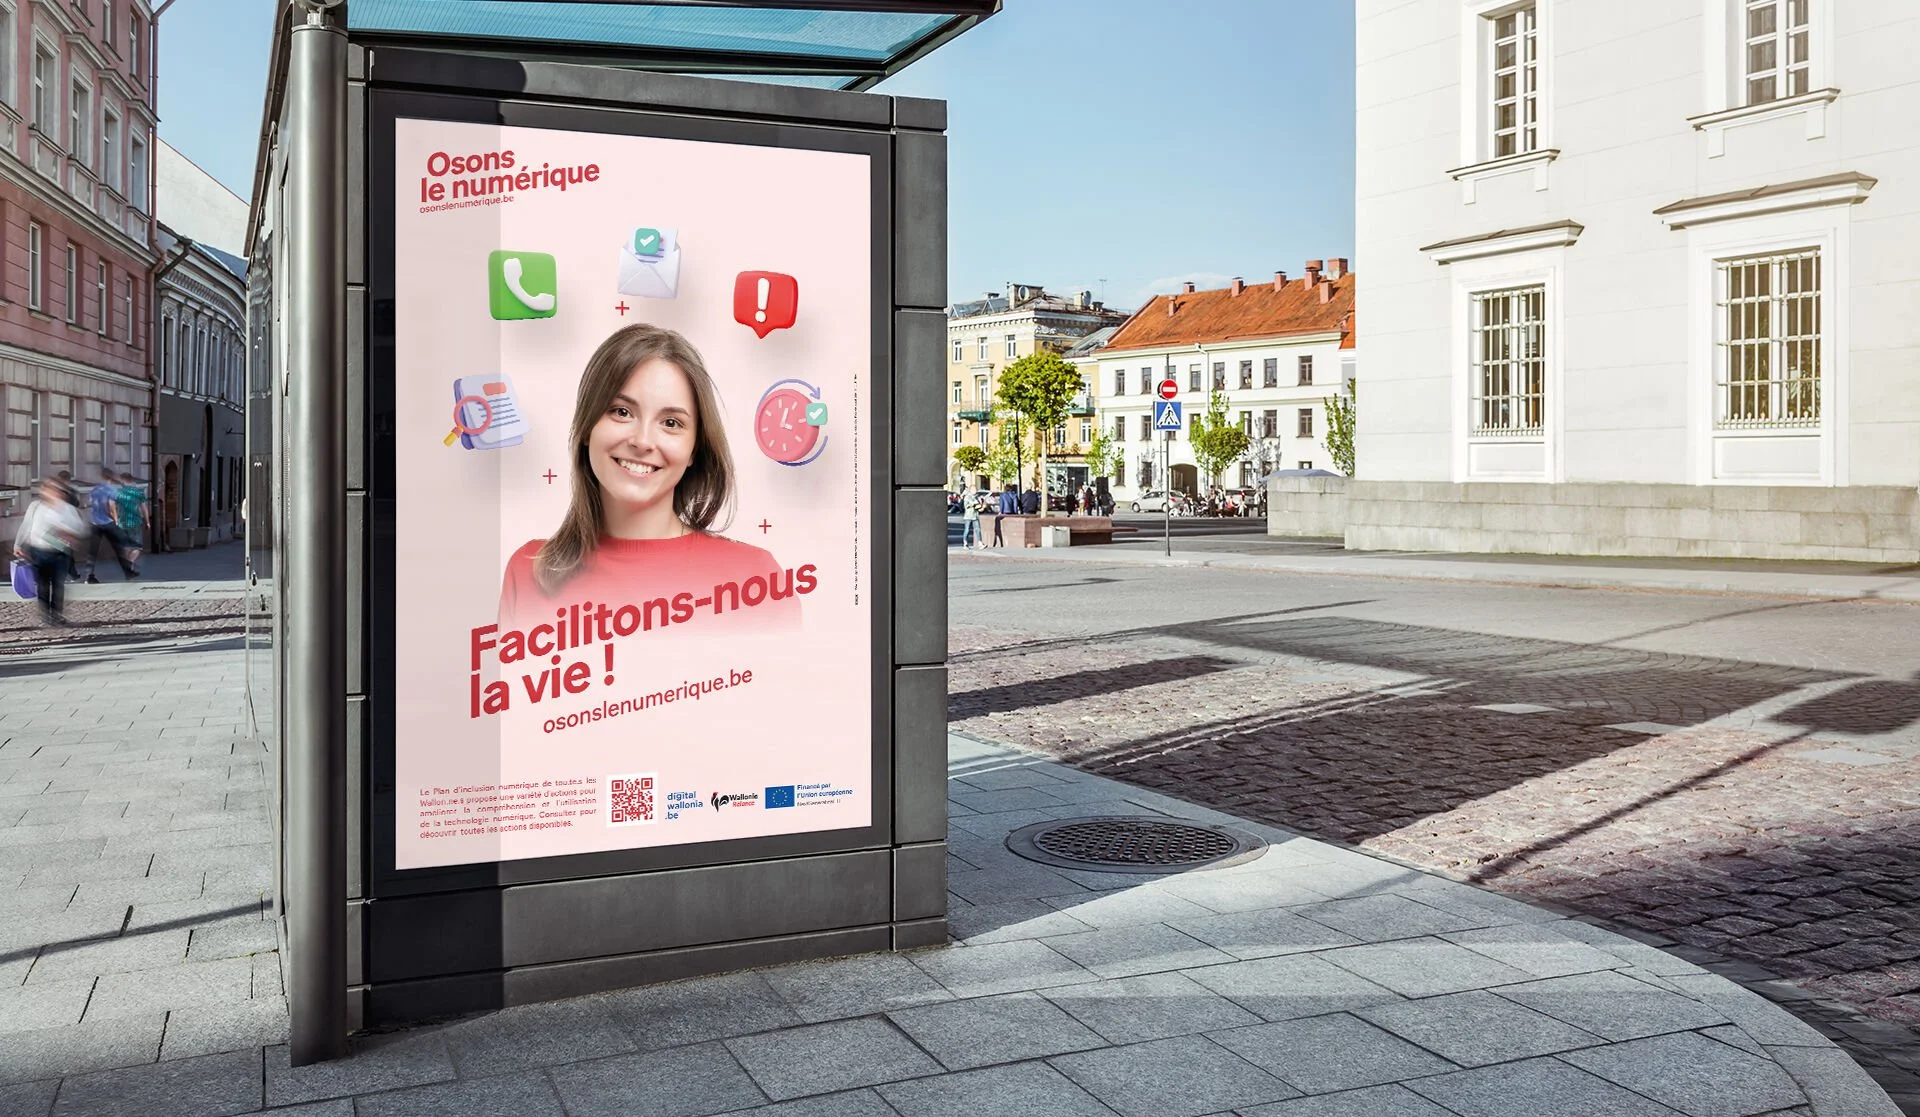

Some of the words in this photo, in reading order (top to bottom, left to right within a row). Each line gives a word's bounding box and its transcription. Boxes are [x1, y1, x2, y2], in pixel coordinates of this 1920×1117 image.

[421, 177, 445, 202] le
[452, 163, 600, 198] numérique
[428, 150, 515, 176] Osons
[471, 564, 818, 671] Facilitons-nous
[470, 674, 510, 719] la
[521, 654, 591, 704] vie
[603, 643, 615, 686] !
[543, 668, 753, 734] osonslenumerique.be
[667, 792, 696, 800] digital
[667, 800, 704, 810] wallonia
